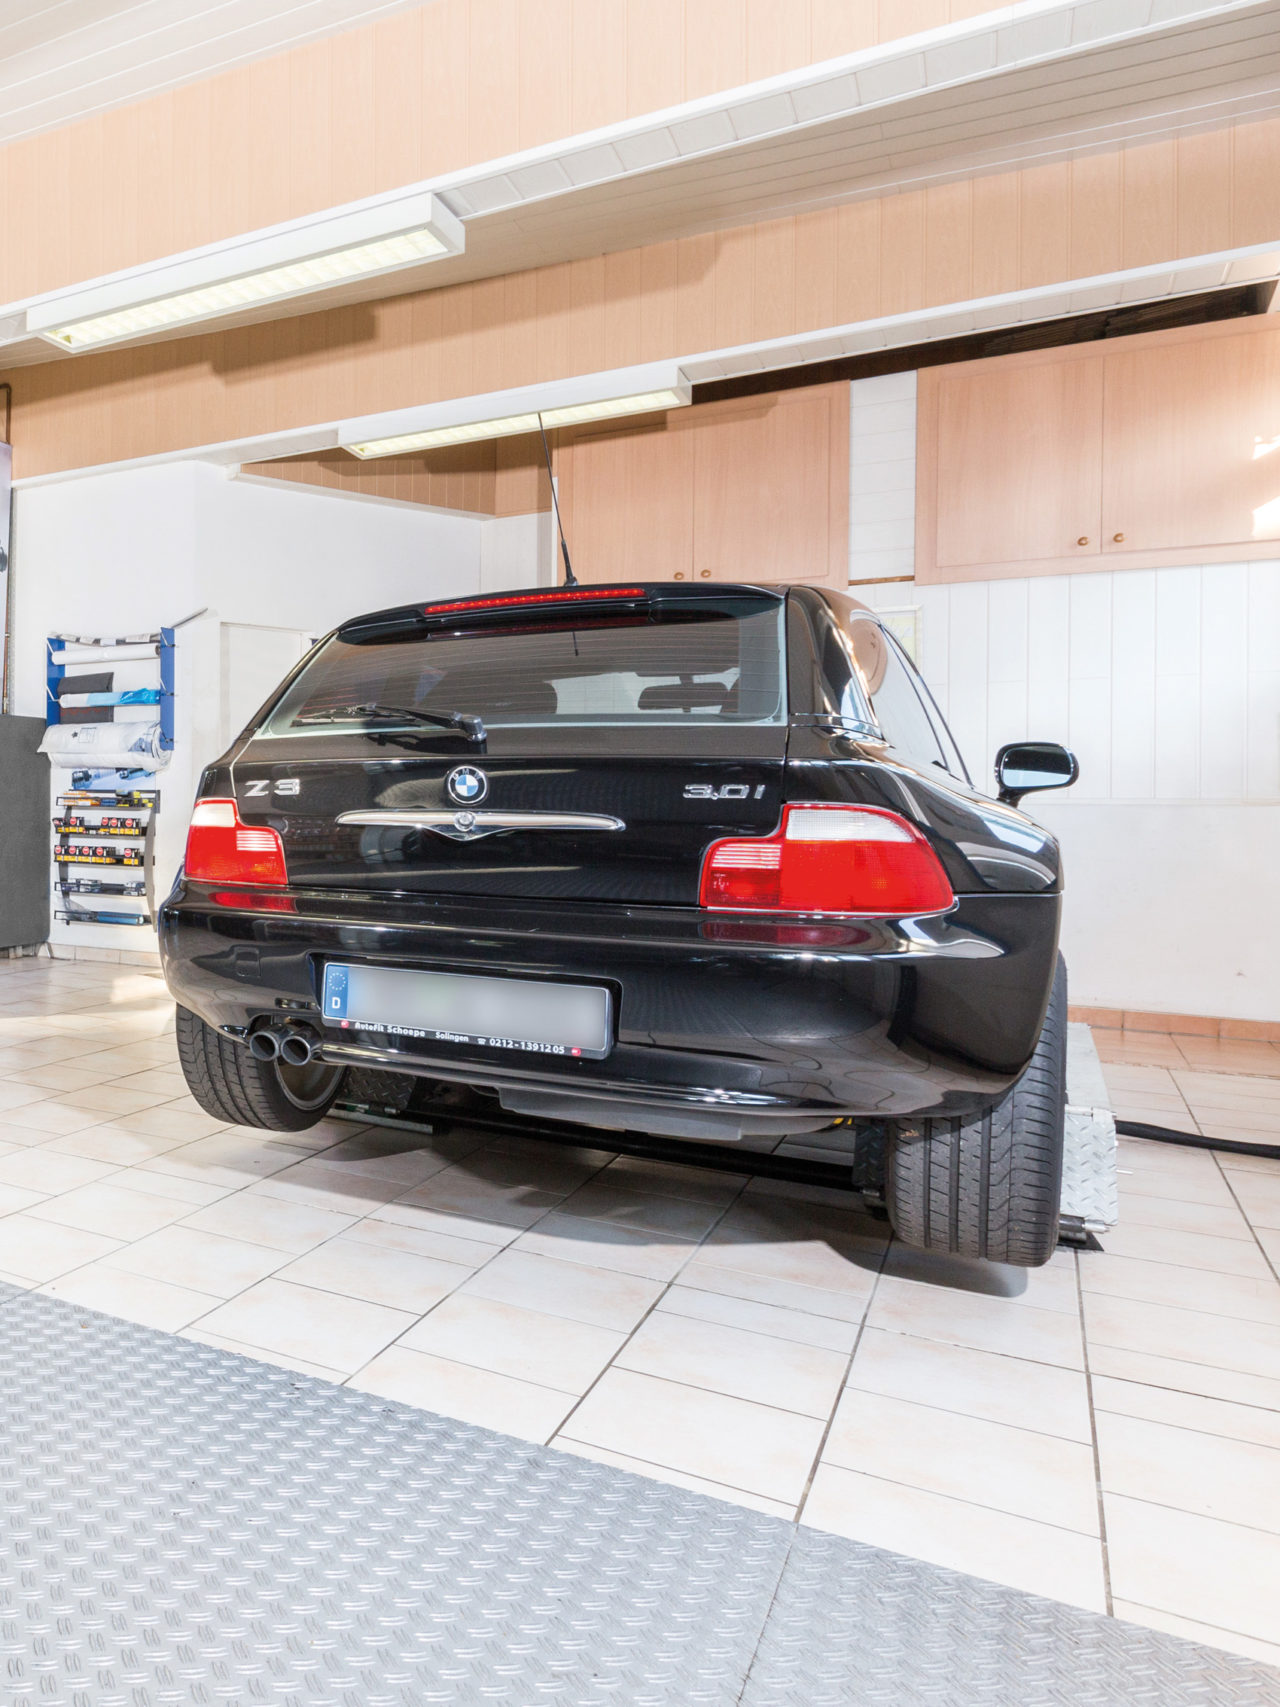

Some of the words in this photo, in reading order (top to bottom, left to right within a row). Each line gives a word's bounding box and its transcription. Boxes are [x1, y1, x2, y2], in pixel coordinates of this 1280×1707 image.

[453, 768, 483, 780] BMW
[331, 996, 341, 1009] D
[387, 1026, 426, 1038] Schoepe
[435, 1031, 470, 1043] Solingen
